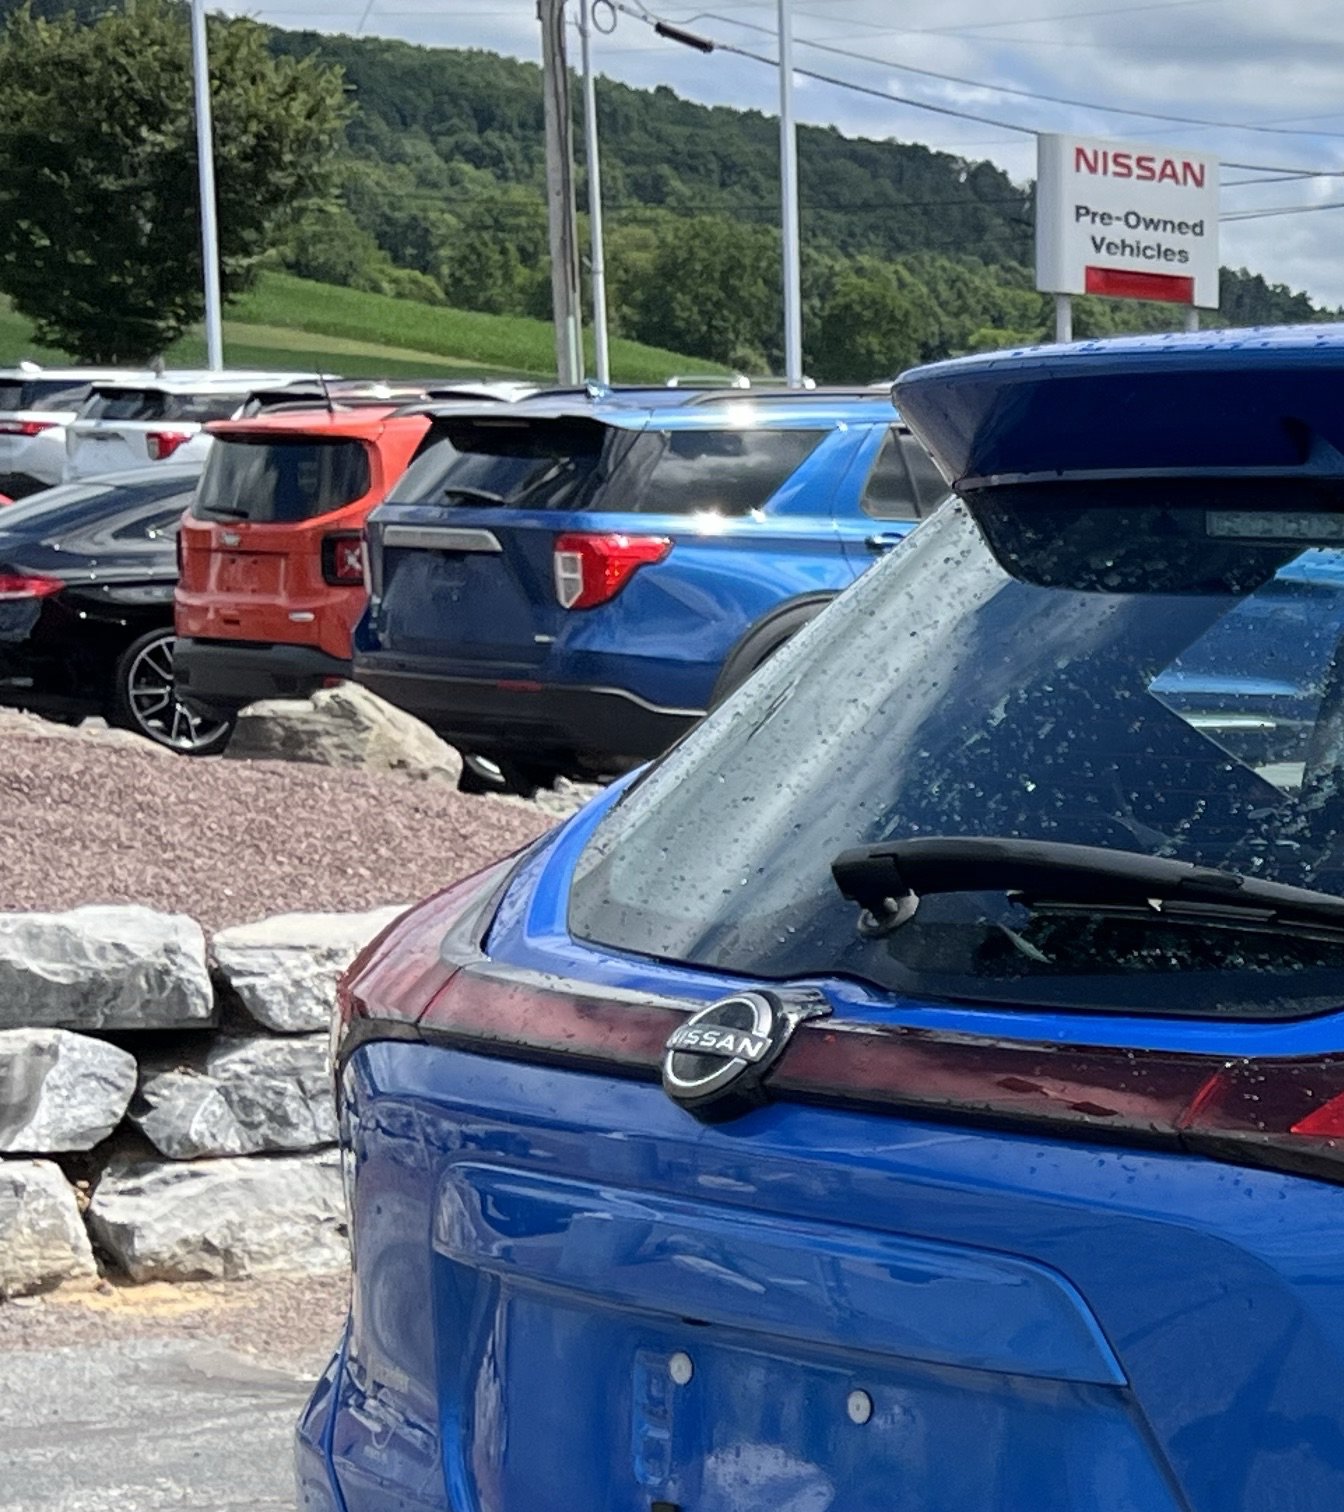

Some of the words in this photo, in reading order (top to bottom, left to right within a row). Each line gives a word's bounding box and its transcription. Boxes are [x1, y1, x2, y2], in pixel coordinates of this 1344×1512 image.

[1074, 147, 1205, 189] NISSAN
[1075, 204, 1205, 237] Pre-Owned
[1091, 235, 1190, 263] Vehicles
[667, 1028, 764, 1058] NISSAN
